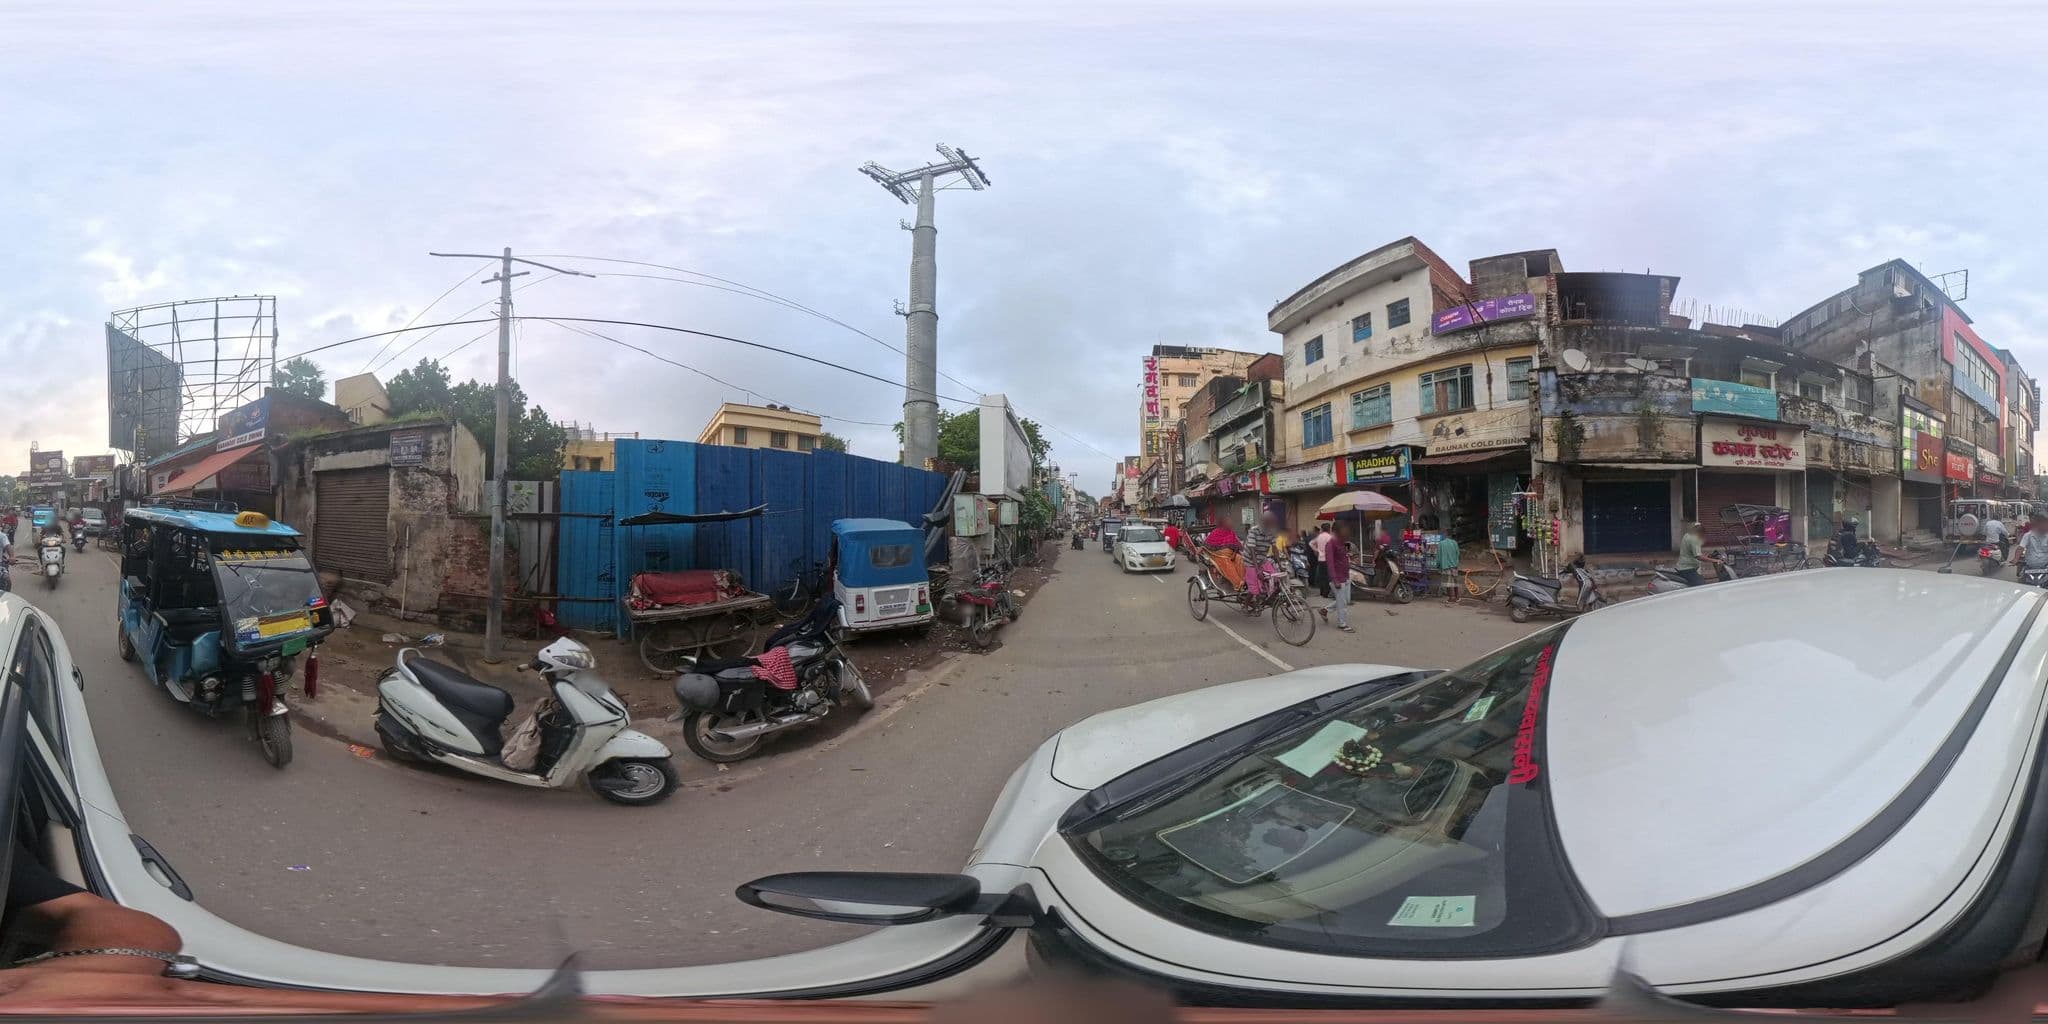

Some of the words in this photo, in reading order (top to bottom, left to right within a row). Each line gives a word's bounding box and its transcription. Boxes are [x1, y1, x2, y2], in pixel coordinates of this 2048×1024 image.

[1435, 442, 1469, 453] RAUNAK
[1470, 440, 1494, 448] COLD
[1356, 455, 1396, 470] ARADHYA
[1919, 448, 1939, 471] She
